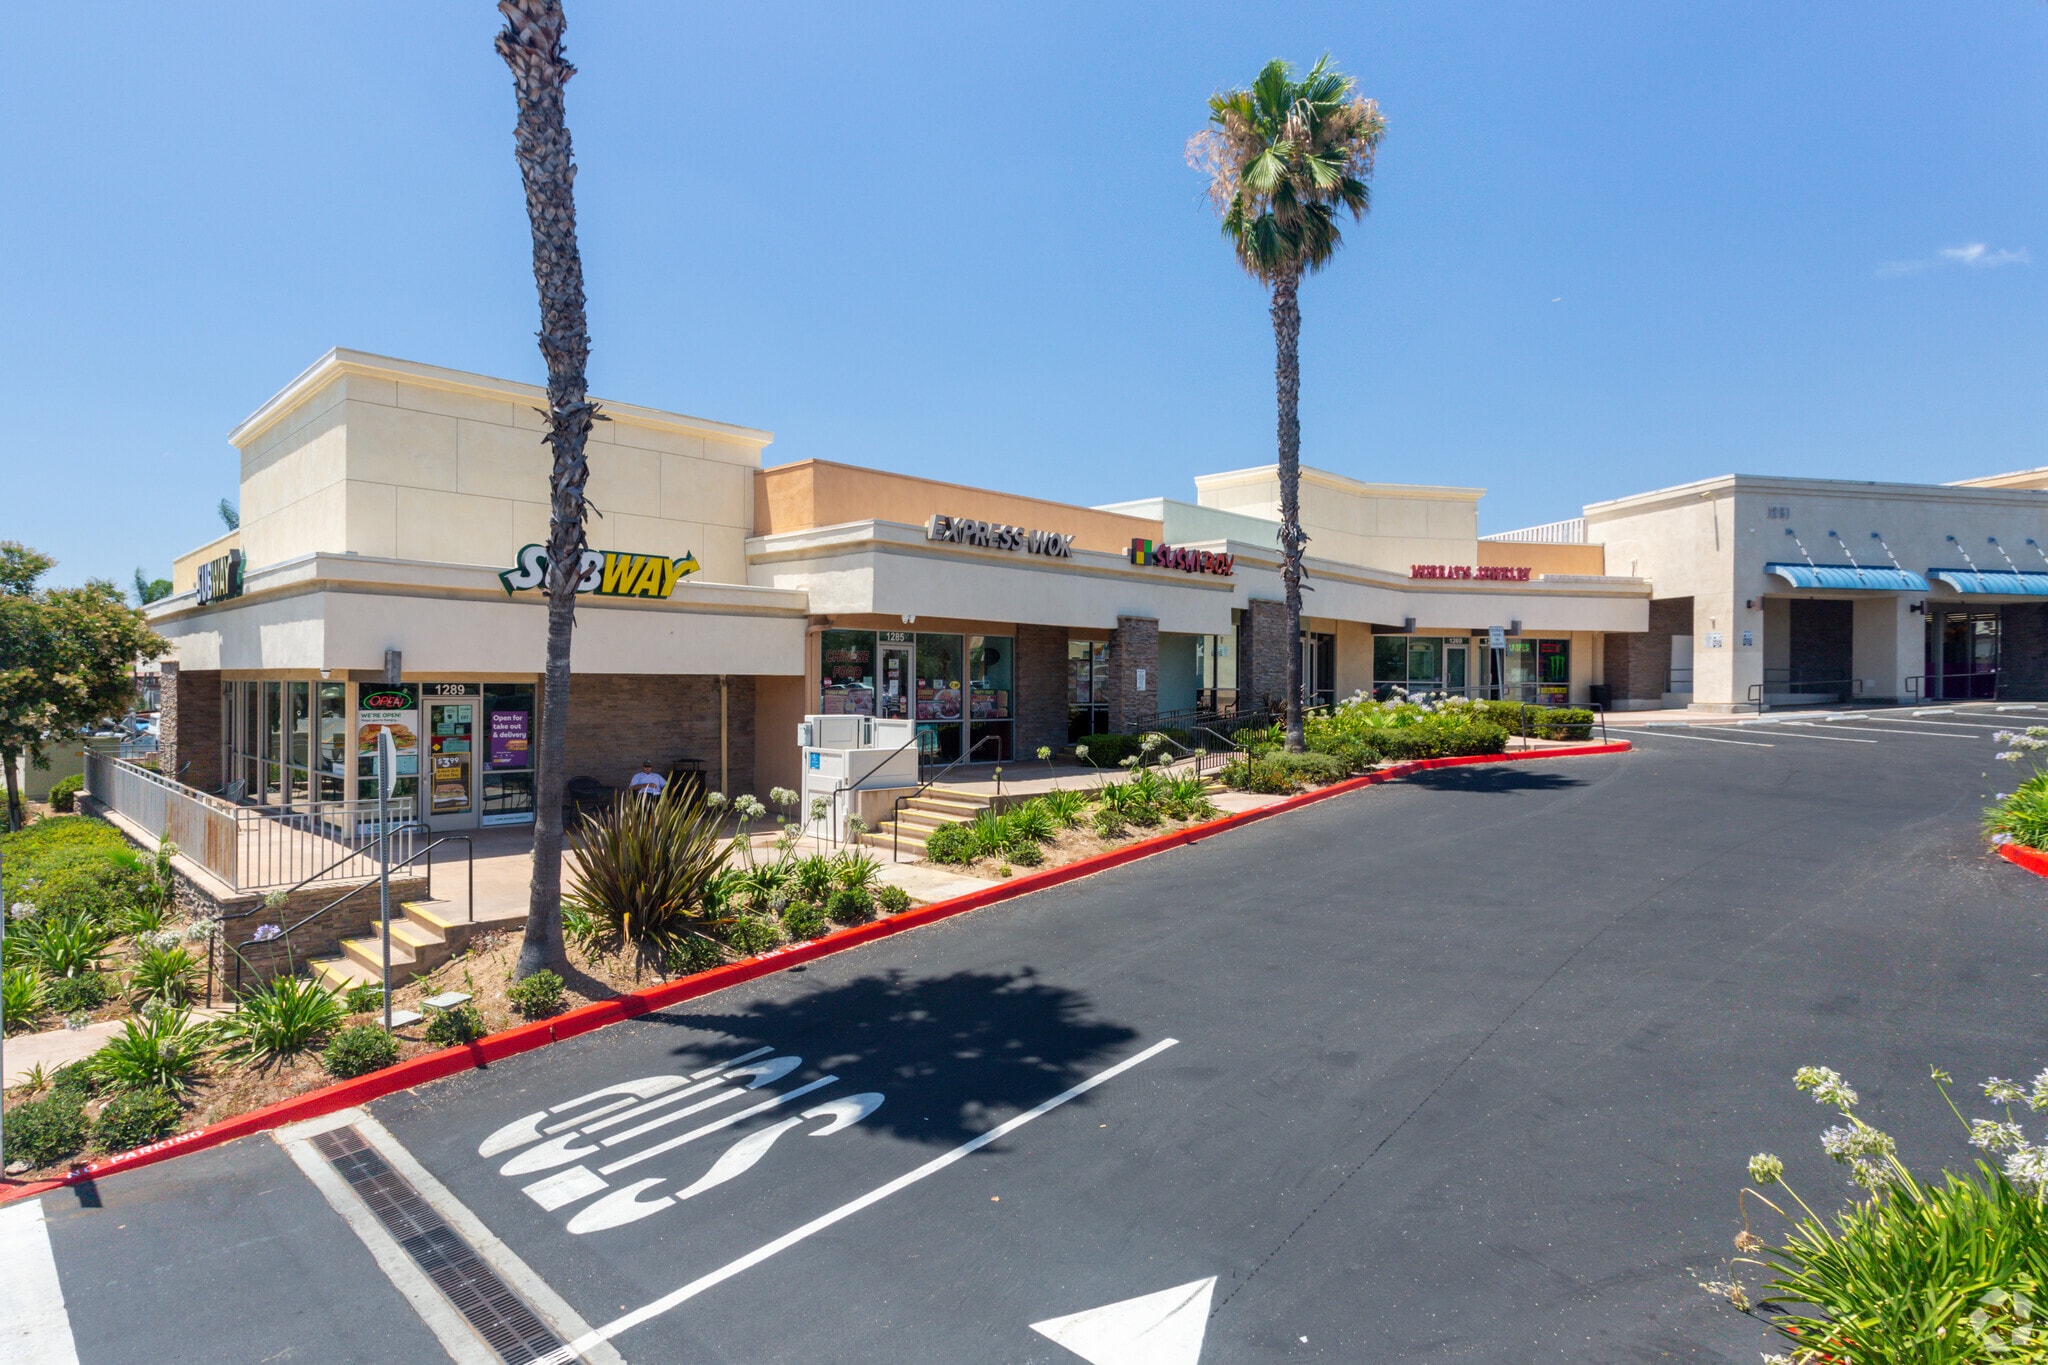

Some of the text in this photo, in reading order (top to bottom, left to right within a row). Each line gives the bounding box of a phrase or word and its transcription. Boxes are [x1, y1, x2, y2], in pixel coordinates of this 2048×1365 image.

[928, 514, 1076, 558] EXPRESS WOK
[1153, 543, 1235, 576] SUSHI BOX
[196, 550, 239, 604] SUBWAY
[498, 543, 701, 600] SBWAY
[1473, 566, 1532, 581] JEWELRY
[886, 632, 905, 642] 1285
[825, 649, 870, 663] CHINESE
[833, 665, 863, 679] FOOD
[435, 684, 465, 695] 1289
[369, 695, 404, 707] OPEN
[499, 731, 527, 739] delivery
[66, 1130, 205, 1179] NO PARKING
